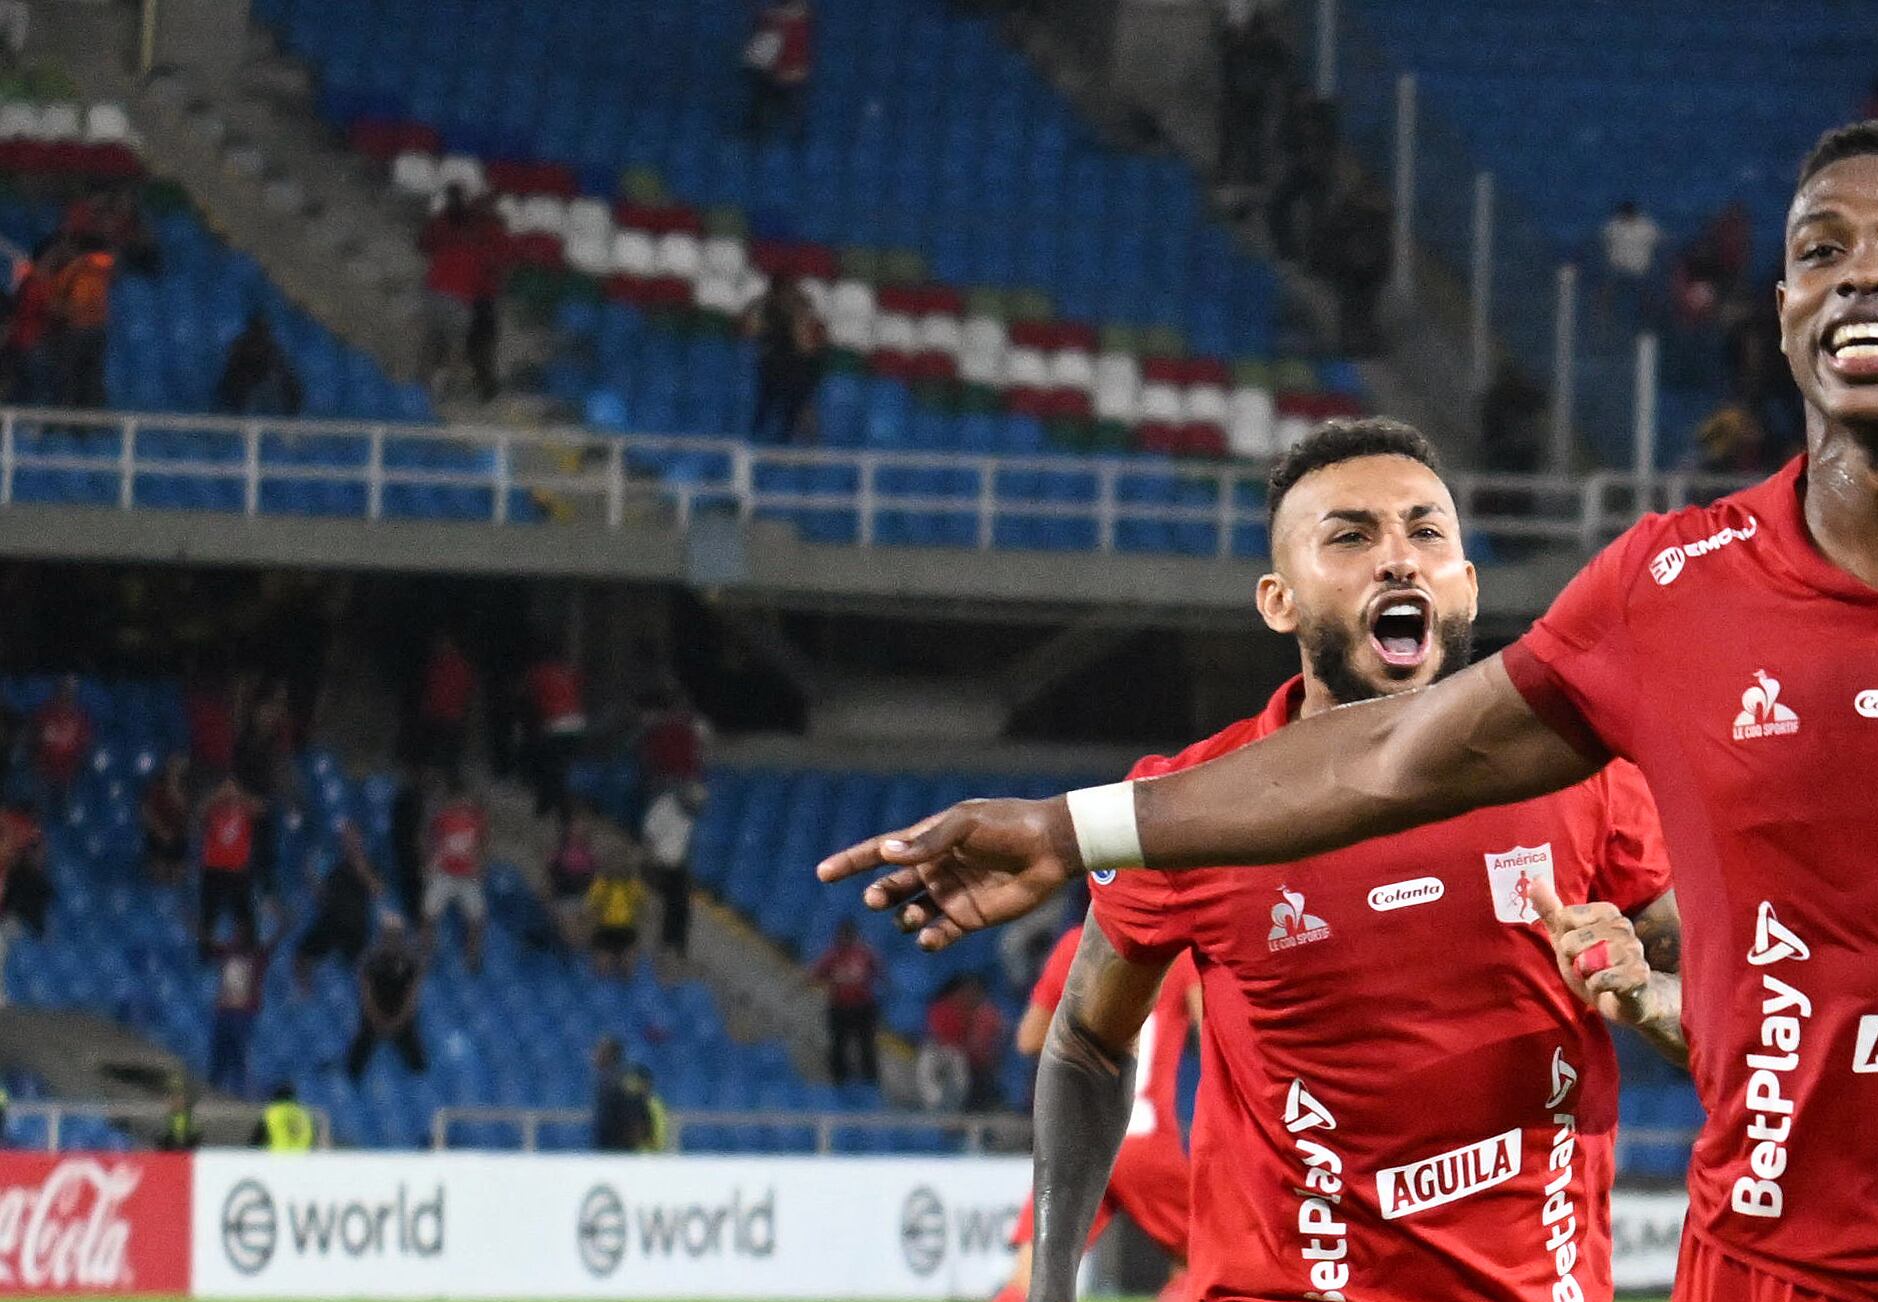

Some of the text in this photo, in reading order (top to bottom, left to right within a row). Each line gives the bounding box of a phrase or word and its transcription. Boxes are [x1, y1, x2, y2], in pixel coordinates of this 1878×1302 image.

[1371, 884, 1441, 906] Colanta
[1493, 851, 1548, 870] América
[1731, 974, 1811, 1219] BetPlay
[1391, 1138, 1513, 1212] AGUILA
[288, 1183, 446, 1259] world
[636, 1183, 777, 1260] world
